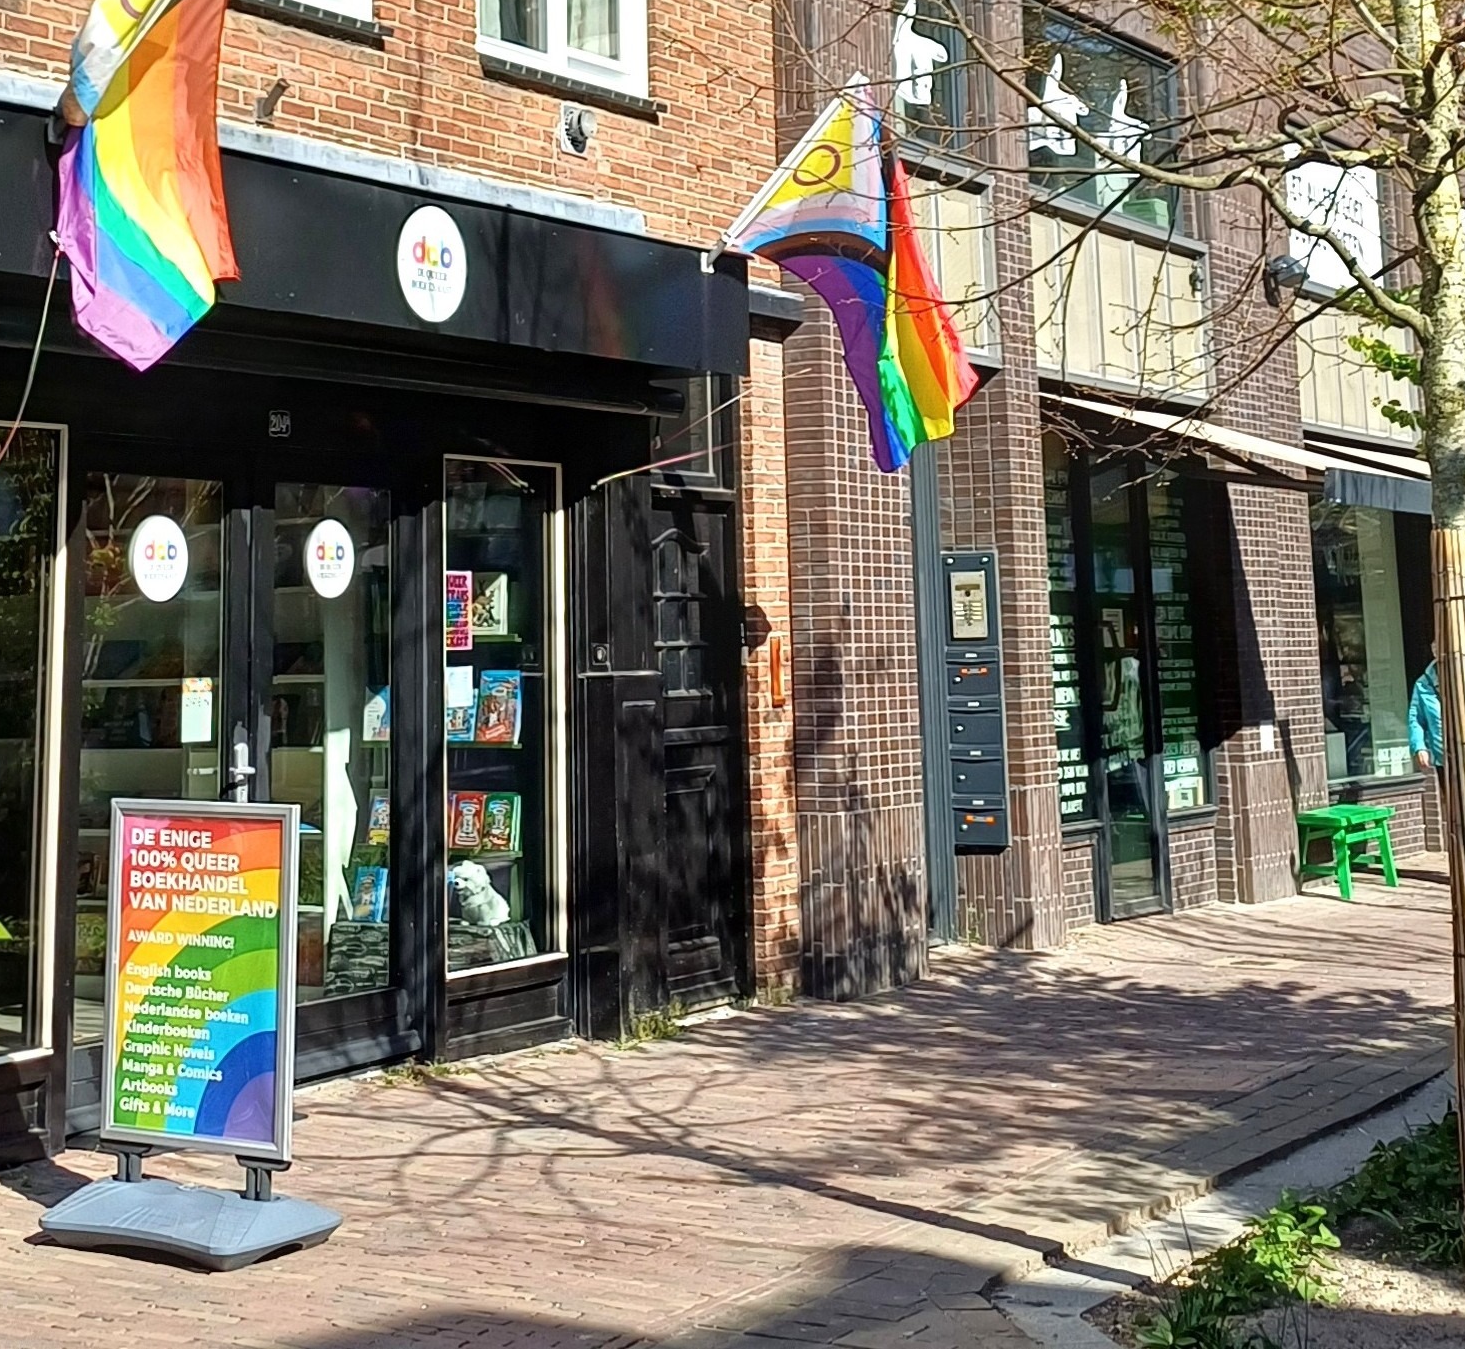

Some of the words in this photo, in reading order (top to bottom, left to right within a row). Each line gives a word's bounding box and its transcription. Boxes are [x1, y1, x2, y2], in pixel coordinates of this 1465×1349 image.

[131, 827, 155, 845] DE
[159, 829, 212, 848] ENIGE
[130, 848, 177, 868] 100%
[181, 852, 240, 872] QUEER
[130, 870, 249, 894] BOEKHANDEL
[129, 892, 167, 911] VAN
[172, 895, 278, 918] NEDERLAND
[127, 929, 174, 944] AWARD
[176, 933, 235, 949] WINNING!
[126, 963, 171, 980] English
[175, 965, 212, 981] books
[124, 981, 182, 998] Deutsche
[185, 986, 229, 1002] Bücher
[124, 1002, 202, 1019] Nederlandse
[205, 1007, 249, 1024] boeken
[123, 1019, 210, 1040] Kinderboeken
[123, 1039, 171, 1056] Graphic
[173, 1044, 214, 1060] Novels
[122, 1058, 163, 1076] Manga
[166, 1063, 174, 1076] &
[177, 1064, 222, 1081] Comics
[121, 1078, 178, 1096] Artbooks
[120, 1096, 150, 1113] Gifts
[152, 1101, 161, 1114] &
[163, 1102, 195, 1118] More
